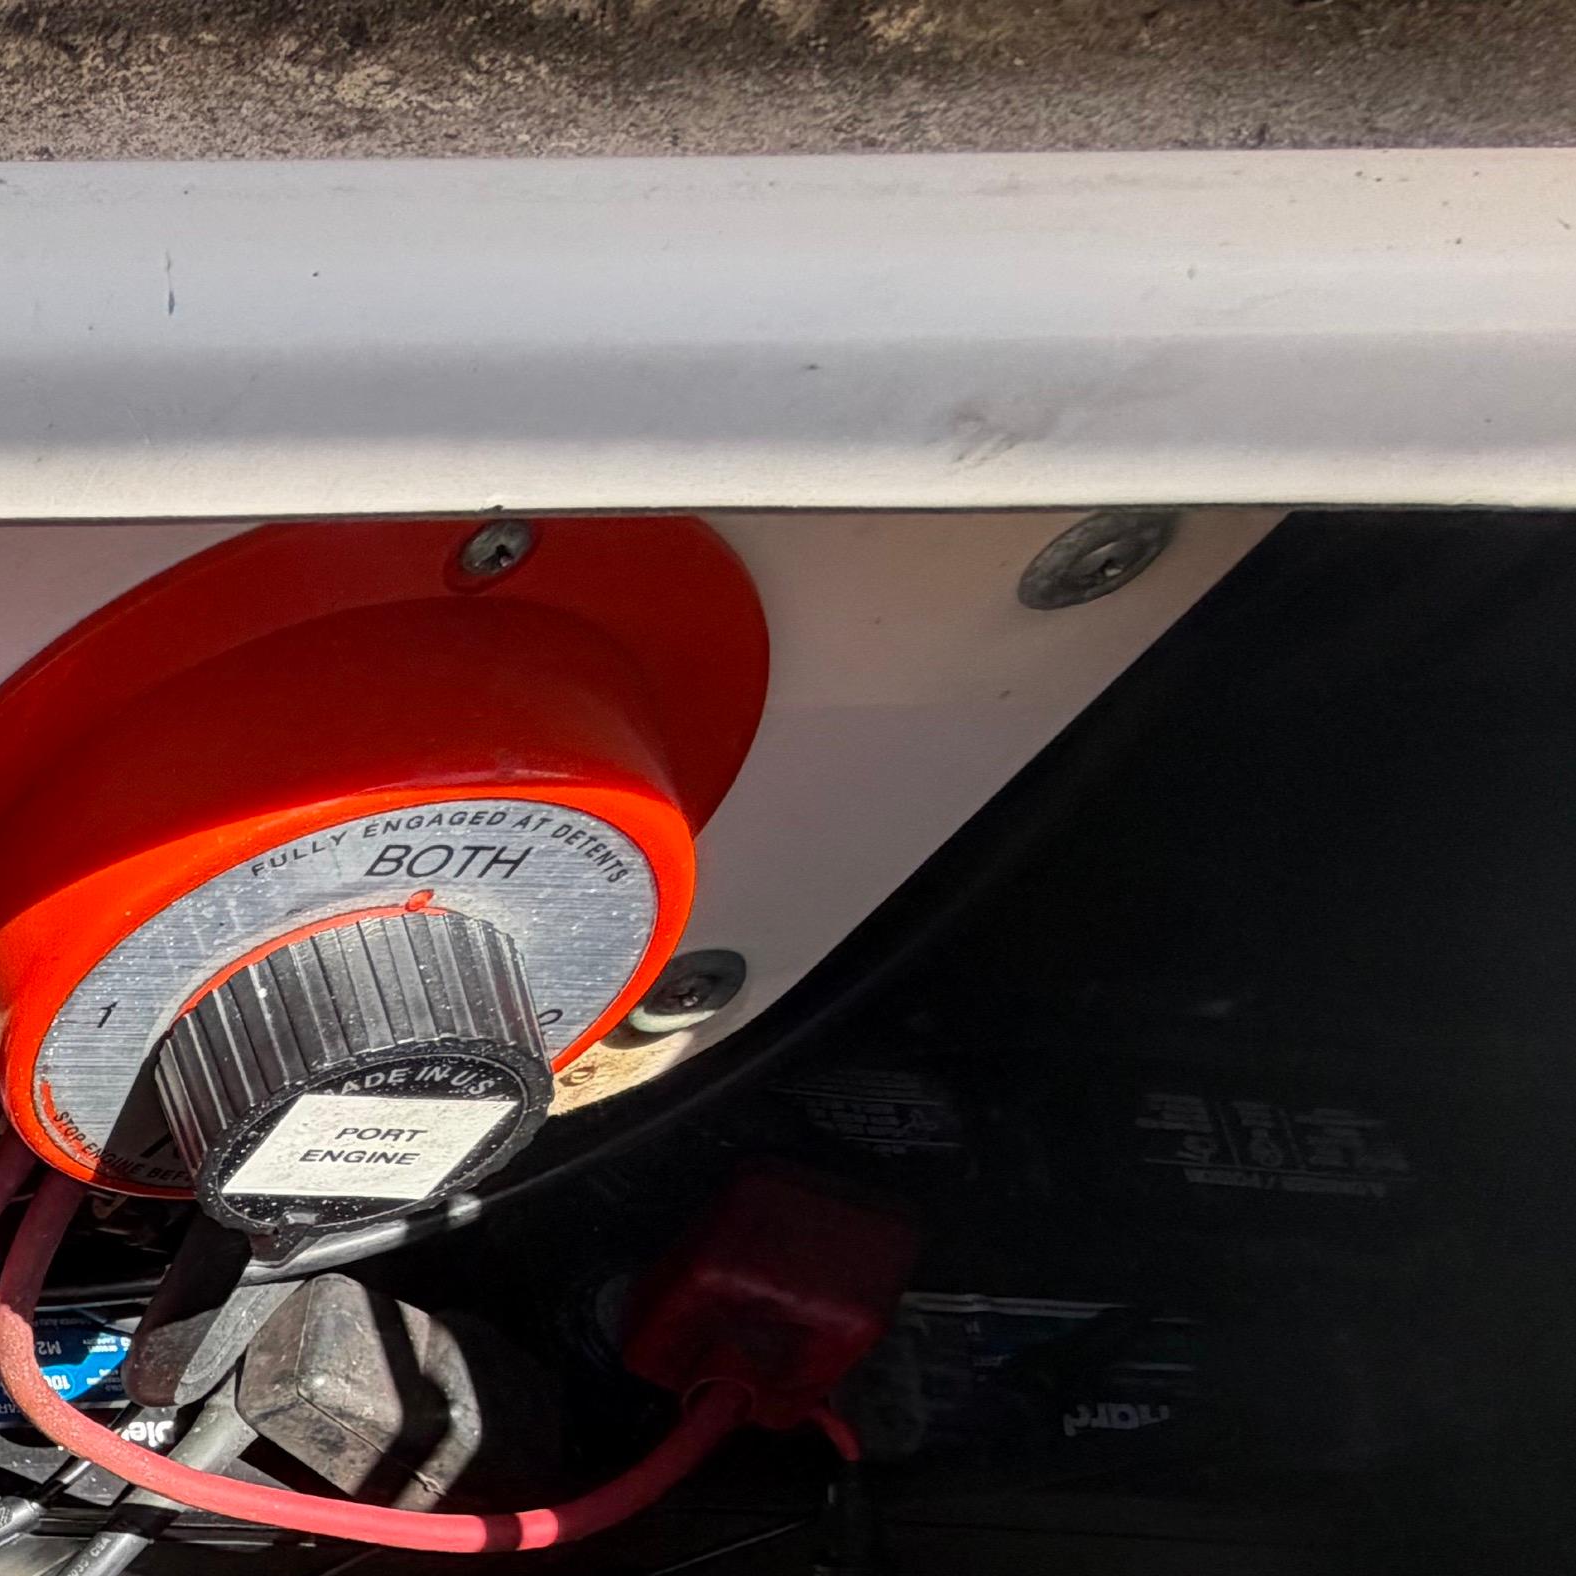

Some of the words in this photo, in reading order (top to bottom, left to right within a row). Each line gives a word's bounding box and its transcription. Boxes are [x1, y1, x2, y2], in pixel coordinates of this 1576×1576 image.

[250, 831, 348, 878] FULLY
[362, 810, 509, 839] ENGAGED
[514, 814, 550, 832] AT
[550, 823, 631, 884] DETENTS
[363, 844, 535, 880] BOTH
[95, 1001, 119, 1029] 1
[324, 1067, 410, 1096] ADE
[414, 1065, 450, 1083] IN
[53, 1111, 87, 1143] STOP
[82, 1142, 146, 1174] ENGINE
[146, 1167, 191, 1183] BEF
[334, 1127, 428, 1142] PORT
[298, 1149, 422, 1165] ENGINE
